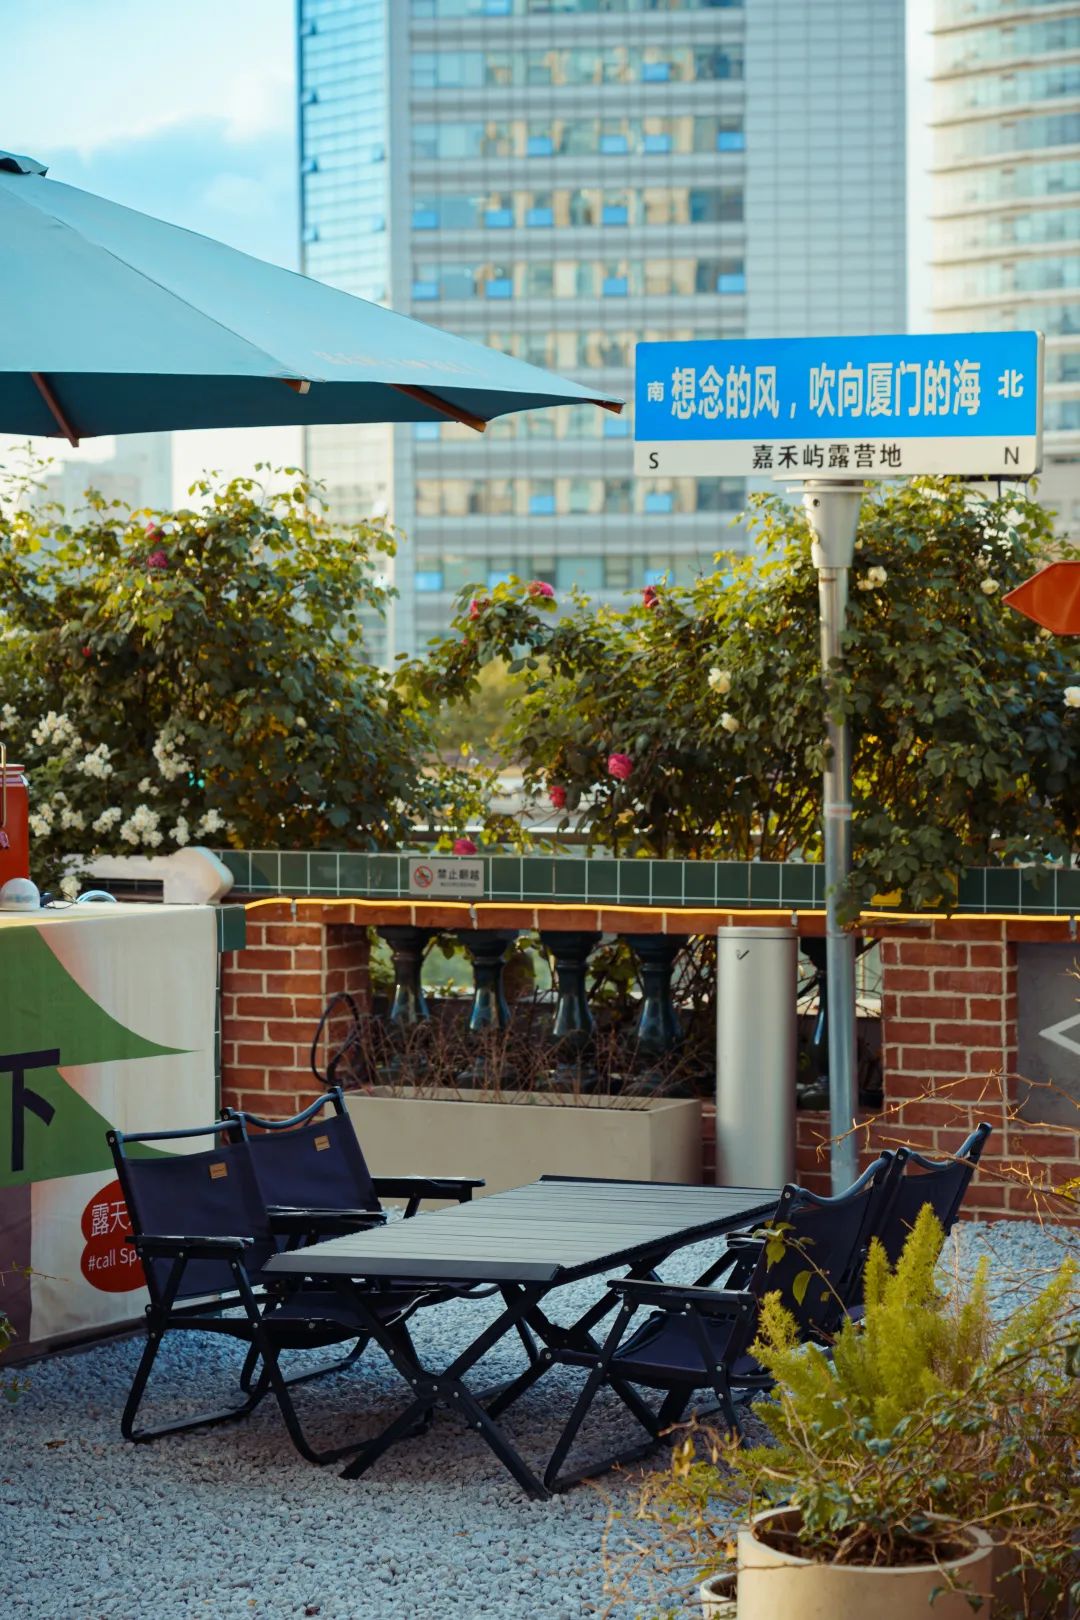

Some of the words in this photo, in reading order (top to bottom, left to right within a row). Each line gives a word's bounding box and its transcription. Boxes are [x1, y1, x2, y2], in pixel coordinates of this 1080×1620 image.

[647, 380, 664, 402] 南
[998, 370, 1023, 399] 北
[648, 452, 659, 469] S
[752, 443, 902, 469] 嘉禾屿露营地
[1004, 446, 1020, 465] N
[91, 1201, 131, 1237] 露天
[88, 1248, 116, 1271] #call
[120, 1247, 141, 1267] Sp
